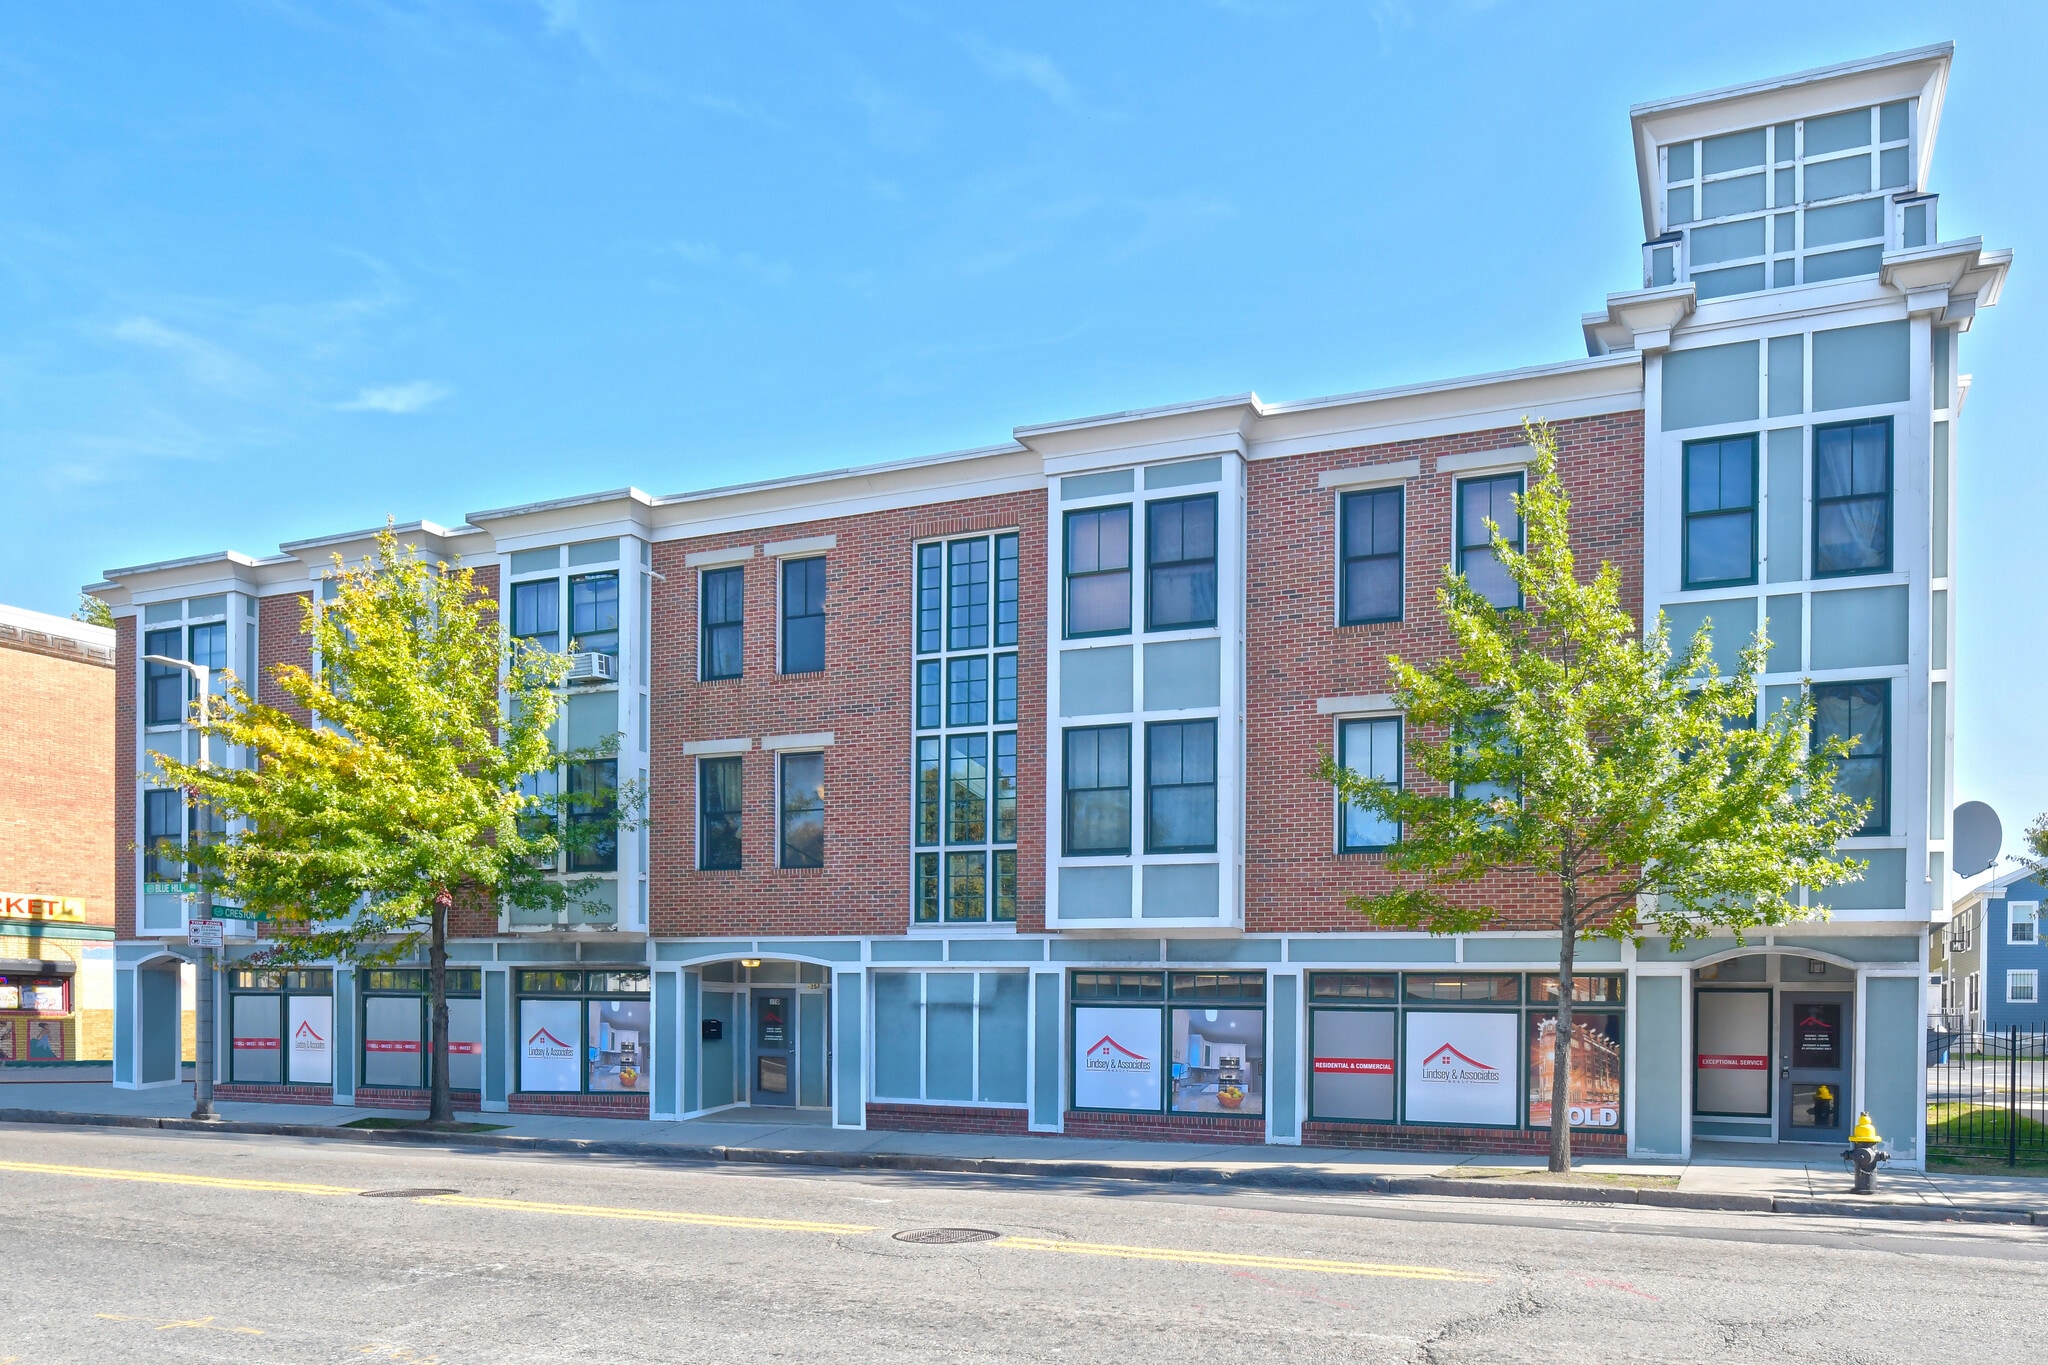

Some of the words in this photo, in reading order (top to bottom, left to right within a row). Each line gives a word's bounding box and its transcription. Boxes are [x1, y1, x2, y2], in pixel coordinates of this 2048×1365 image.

[155, 884, 170, 893] BLUE
[171, 884, 183, 893] HILL
[0, 896, 59, 915] KET
[225, 908, 256, 919] CRESTON
[528, 1047, 545, 1056] Lindsey
[546, 1047, 550, 1056] &
[550, 1048, 573, 1056] Associates
[1086, 1059, 1109, 1069] Lindsey
[1111, 1059, 1116, 1068] &
[1118, 1059, 1150, 1069] Associates
[1422, 1068, 1450, 1080] Lindsey
[1452, 1069, 1458, 1079] &
[1460, 1069, 1499, 1080] Associates
[1550, 1107, 1618, 1126] OLD
